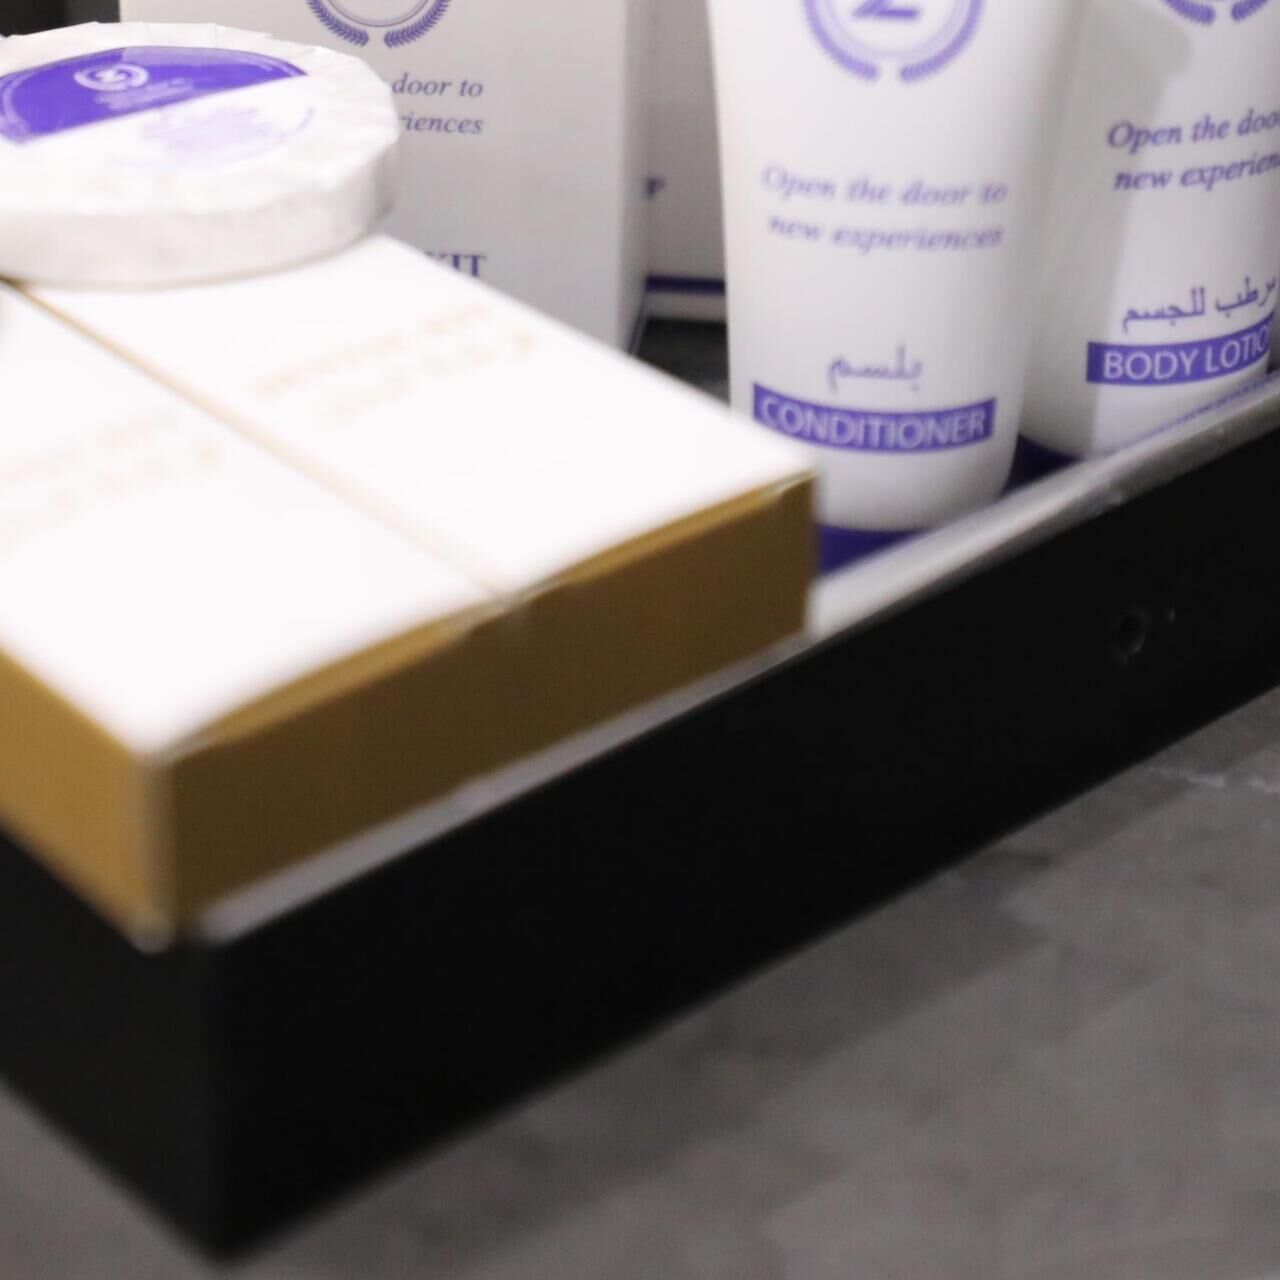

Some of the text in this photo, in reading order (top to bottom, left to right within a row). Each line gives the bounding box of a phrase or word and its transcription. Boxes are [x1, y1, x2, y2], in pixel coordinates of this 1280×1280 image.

[392, 73, 483, 98] door to
[1108, 121, 1182, 154] Open
[1191, 113, 1230, 143] the
[762, 164, 1008, 205] Open the door to
[1114, 167, 1171, 191] new
[769, 217, 1004, 255] new experiences
[1122, 286, 1206, 334] للجسم
[828, 342, 923, 394] بلسم
[1104, 348, 1198, 381] BODY
[761, 397, 986, 448] CONDITIONER
